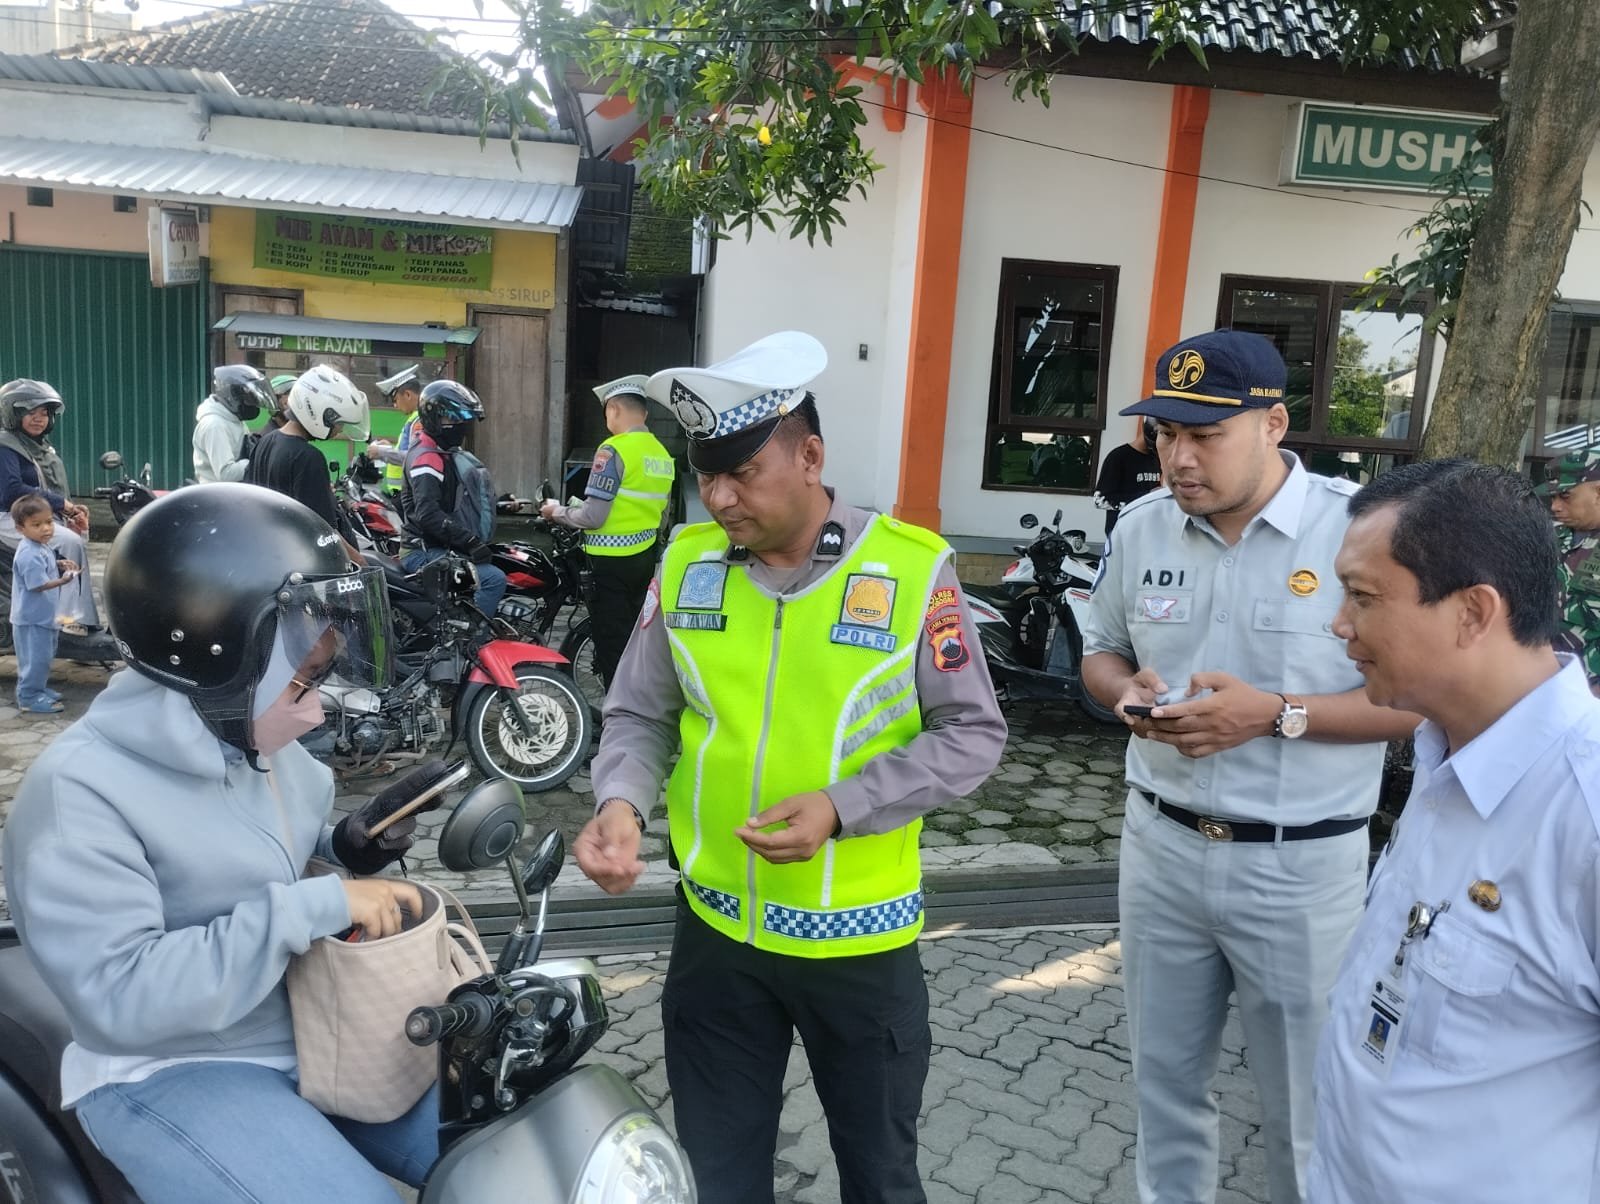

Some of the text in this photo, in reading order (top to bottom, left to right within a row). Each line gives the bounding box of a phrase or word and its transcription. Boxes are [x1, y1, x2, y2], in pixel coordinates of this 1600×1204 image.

[276, 216, 312, 241] MIE
[320, 223, 373, 250] AYAM
[381, 230, 397, 252] &
[271, 242, 306, 253] ES TEH
[286, 252, 312, 262] SUSU
[326, 250, 375, 262] ES JERUK
[286, 260, 309, 269] KOPI
[325, 258, 395, 272] ES NUTRISARI
[433, 259, 465, 267] PANAS
[341, 267, 370, 276] SIRUP
[436, 267, 468, 275] PANAS
[401, 273, 477, 283] GORENGAN
[510, 288, 551, 303] SIRUP
[238, 335, 282, 349] TUTUP
[297, 336, 321, 351] MIE
[1142, 569, 1185, 587] ADI
[929, 589, 953, 604] OLRES
[836, 628, 893, 649] POLRI
